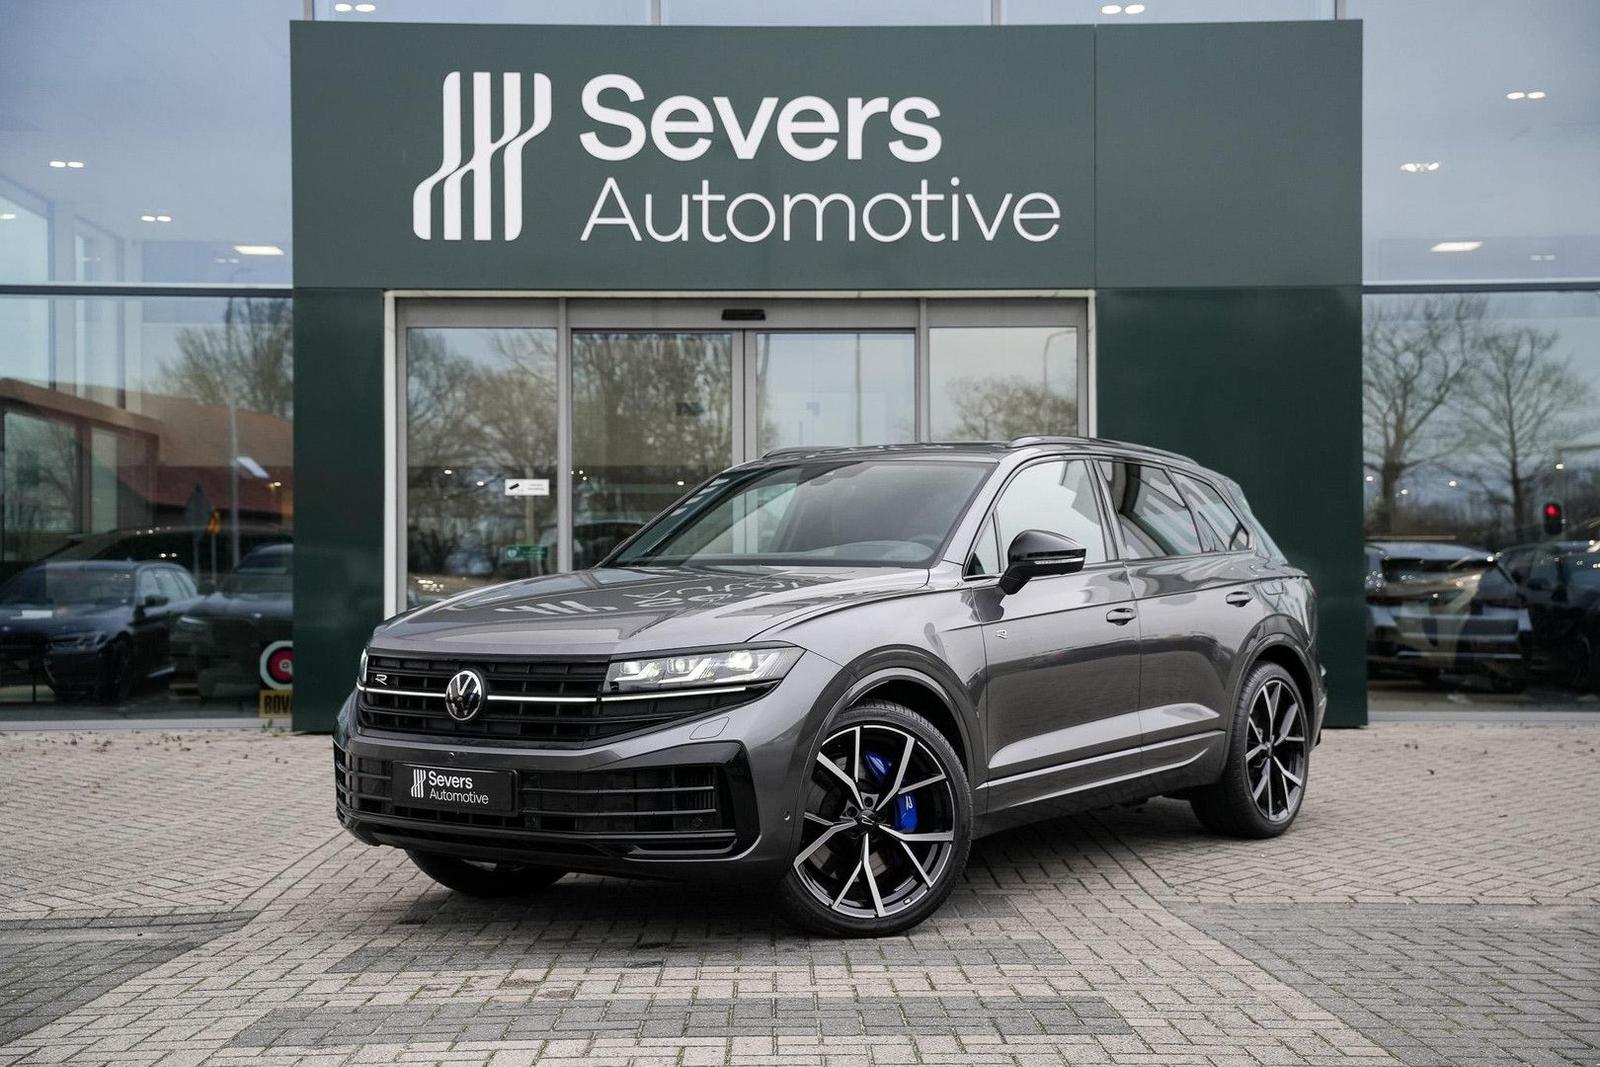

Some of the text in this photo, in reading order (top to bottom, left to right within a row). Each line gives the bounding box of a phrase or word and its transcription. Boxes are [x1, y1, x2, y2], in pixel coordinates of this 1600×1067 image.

[580, 74, 941, 162] Severs
[581, 177, 1060, 242] Automotive
[375, 674, 388, 685] R
[264, 695, 293, 714] BOV
[428, 770, 473, 789] Severs
[429, 788, 489, 804] Automotive
